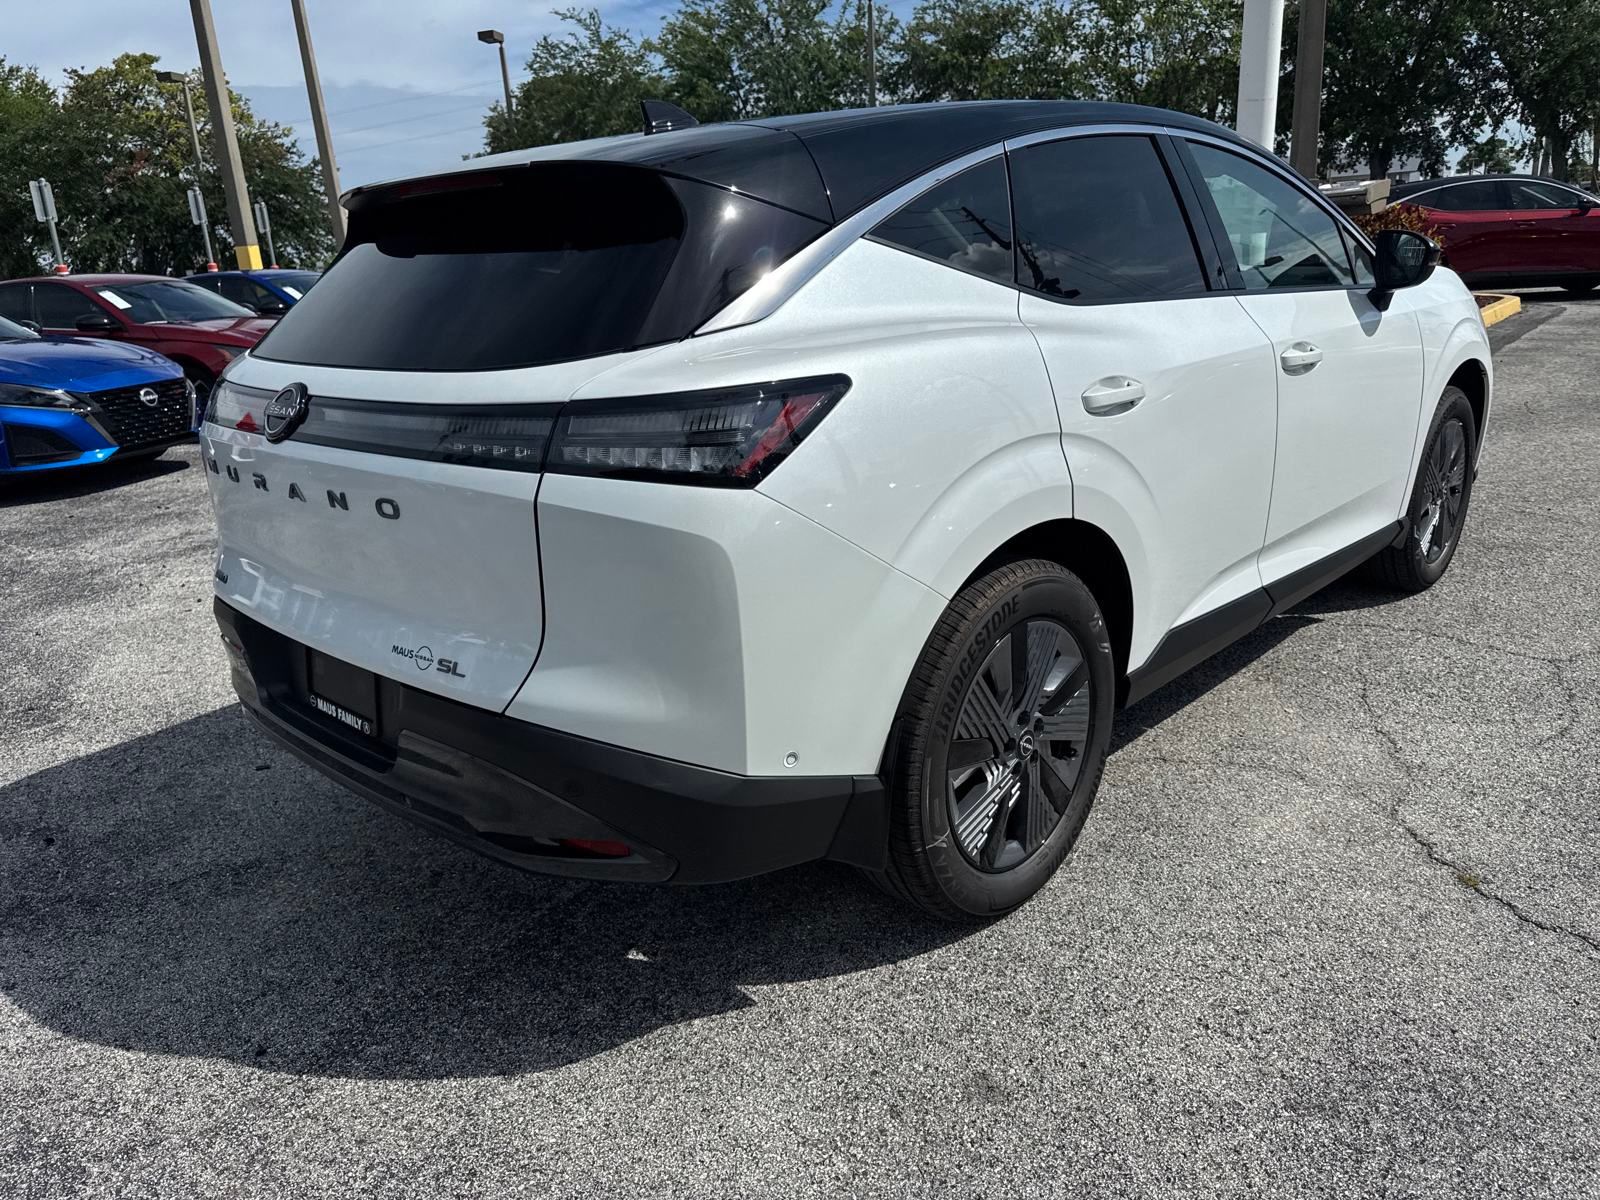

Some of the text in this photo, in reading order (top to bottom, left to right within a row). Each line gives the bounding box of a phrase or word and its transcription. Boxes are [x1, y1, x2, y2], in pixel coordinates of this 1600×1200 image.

[266, 403, 297, 416] SSAN
[207, 455, 401, 520] MURANO
[391, 644, 414, 659] MAUS
[436, 658, 466, 678] SL
[934, 594, 1021, 743] BRIDGESTONE
[317, 697, 362, 731] MAUS FAMILY
